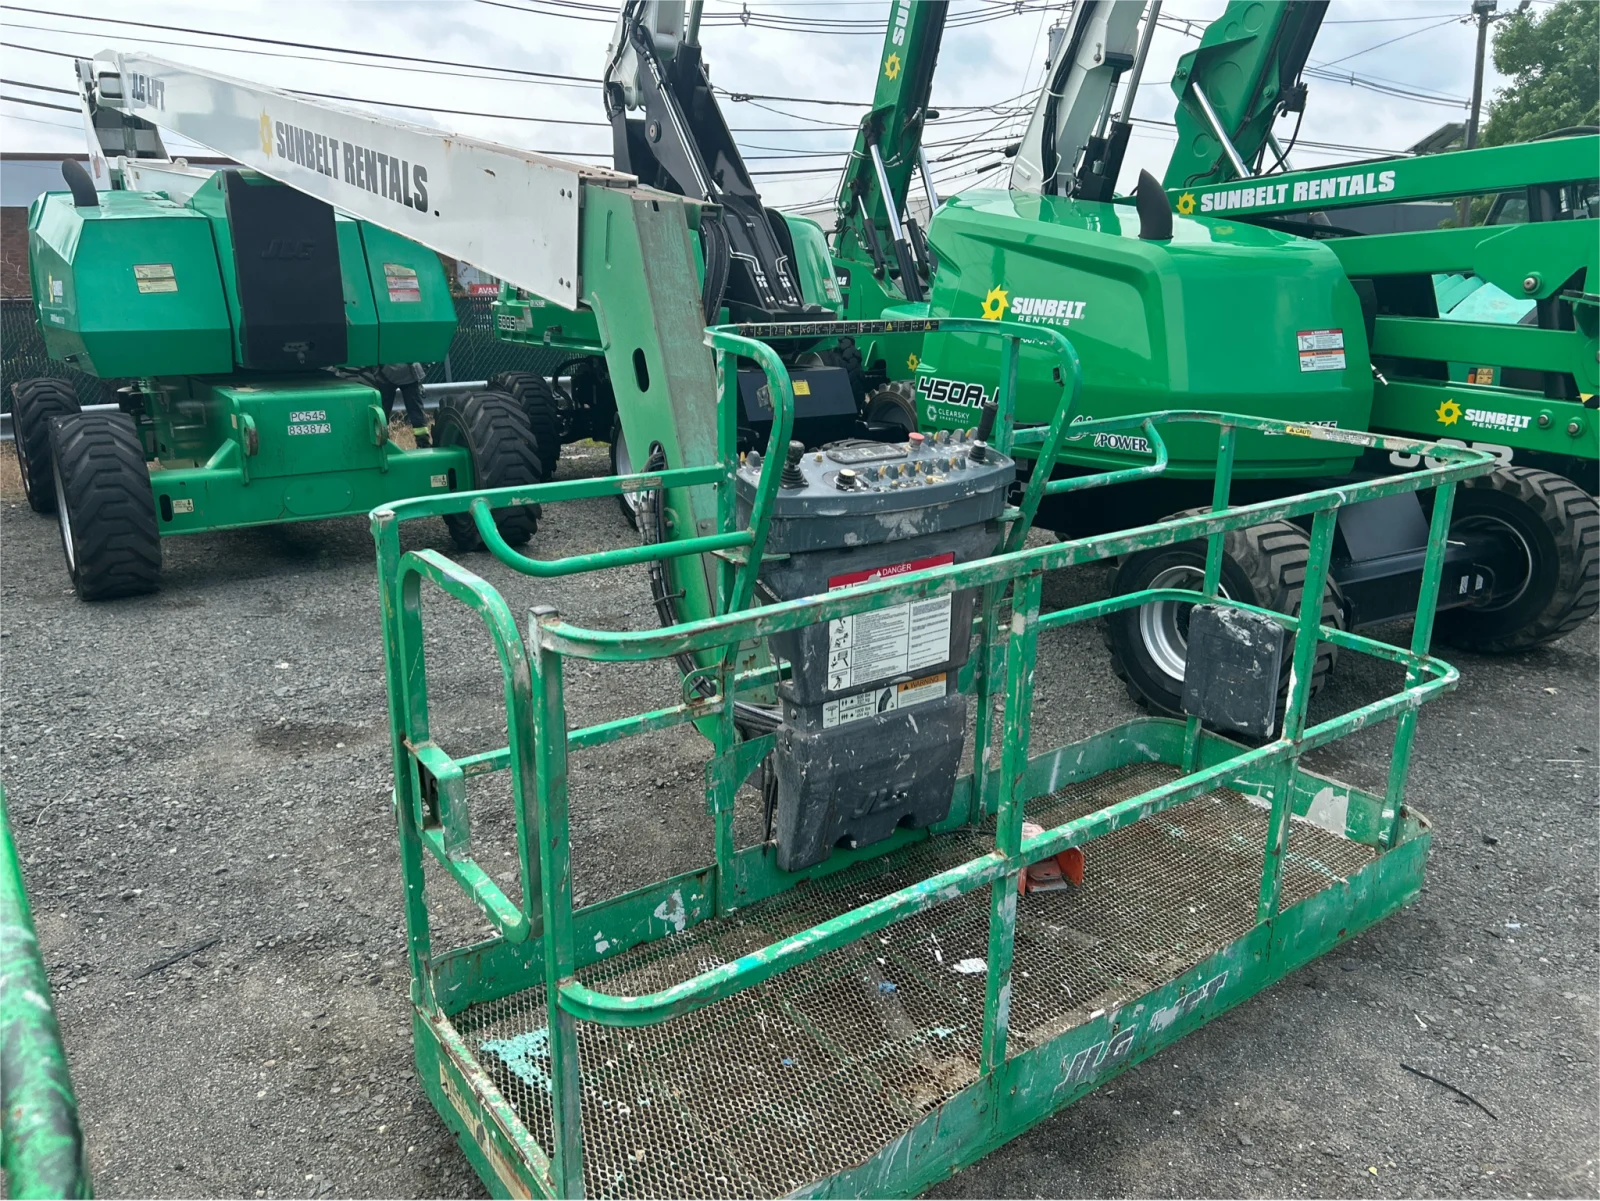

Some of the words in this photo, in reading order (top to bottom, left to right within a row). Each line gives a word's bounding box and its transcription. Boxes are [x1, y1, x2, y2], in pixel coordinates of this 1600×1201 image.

[131, 72, 145, 102] JLG
[146, 77, 165, 111] LIFT
[275, 120, 339, 180] SUNBELT
[342, 141, 428, 213] RENTALS
[1200, 183, 1289, 212] SUNBELT
[1293, 170, 1396, 202] RENTALS
[1010, 296, 1087, 319] SUNBELT
[1017, 315, 1070, 326] RENTALS
[290, 410, 326, 422] PC545
[938, 407, 970, 420] CLEARSKY
[1464, 408, 1532, 429] SUNBELT
[289, 423, 331, 435] 833873
[1471, 421, 1519, 433] RENTALS
[882, 563, 912, 576] DANGER
[910, 675, 939, 689] WARNING
[1052, 1023, 1137, 1101] JLG
